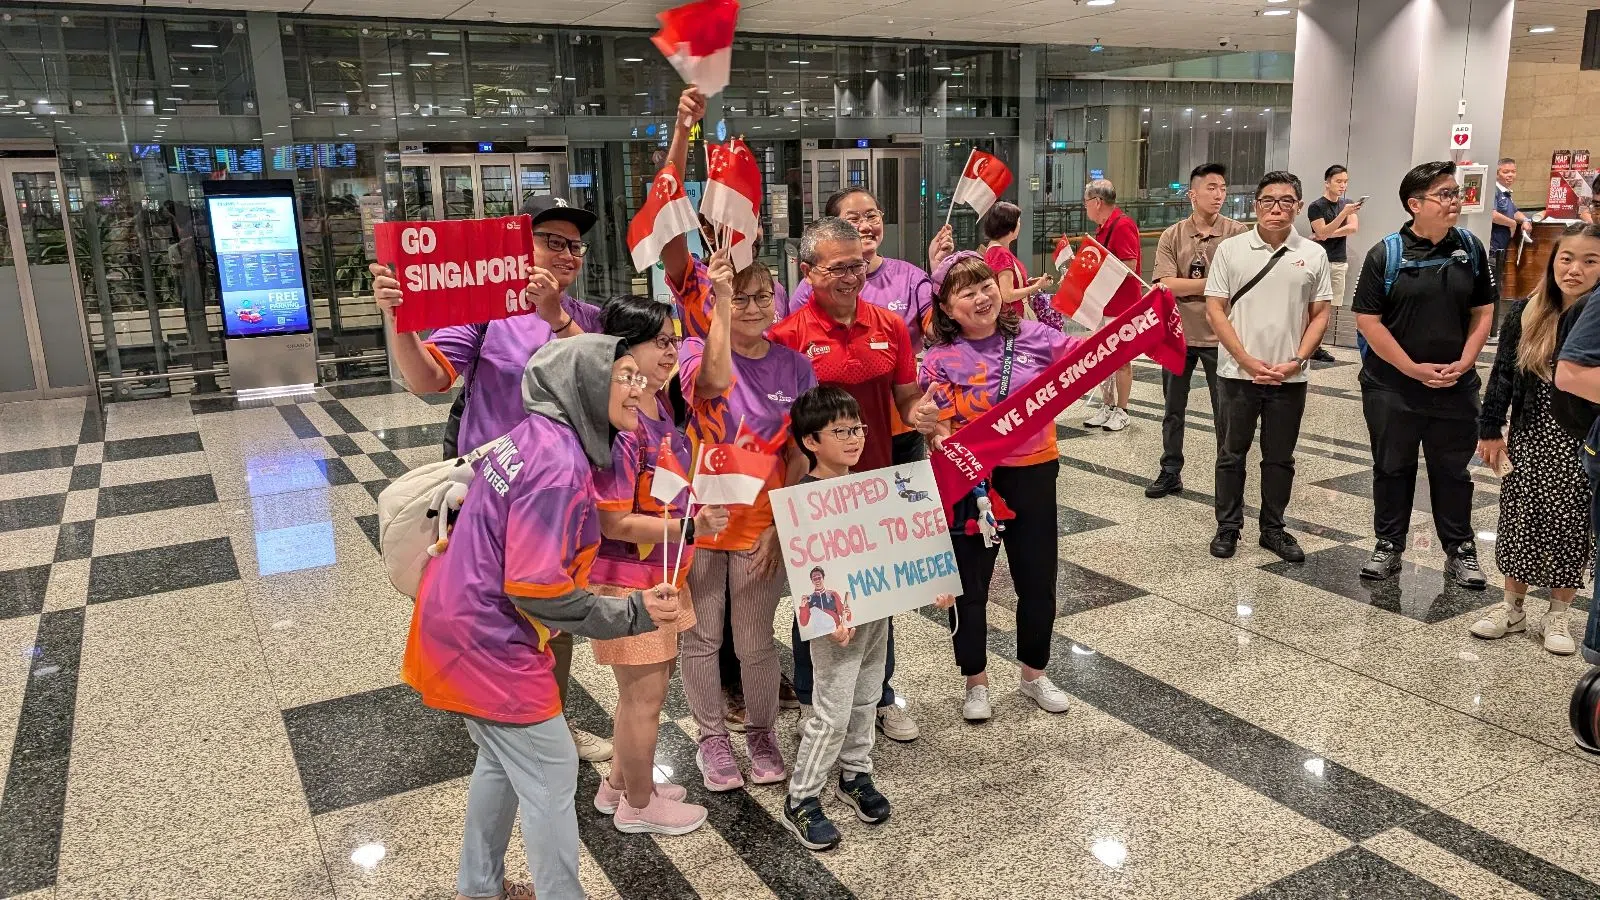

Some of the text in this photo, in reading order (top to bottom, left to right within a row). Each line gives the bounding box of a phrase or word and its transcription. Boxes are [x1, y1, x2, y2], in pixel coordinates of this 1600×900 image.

[401, 227, 437, 255] GO
[404, 254, 530, 292] SINGAPORE
[268, 291, 299, 302] FREE
[270, 302, 299, 310] PARKING
[991, 307, 1161, 436] WE ARE SINGAPORE
[1003, 356, 1012, 374] 2024
[1000, 375, 1009, 396] PARIS
[942, 444, 978, 481] HEALTH
[949, 441, 984, 473] ACTIVE
[787, 477, 889, 528] I SKIPPED
[789, 507, 947, 568] SCHOOL TO SEE
[847, 551, 958, 600] MAX MAEDER
